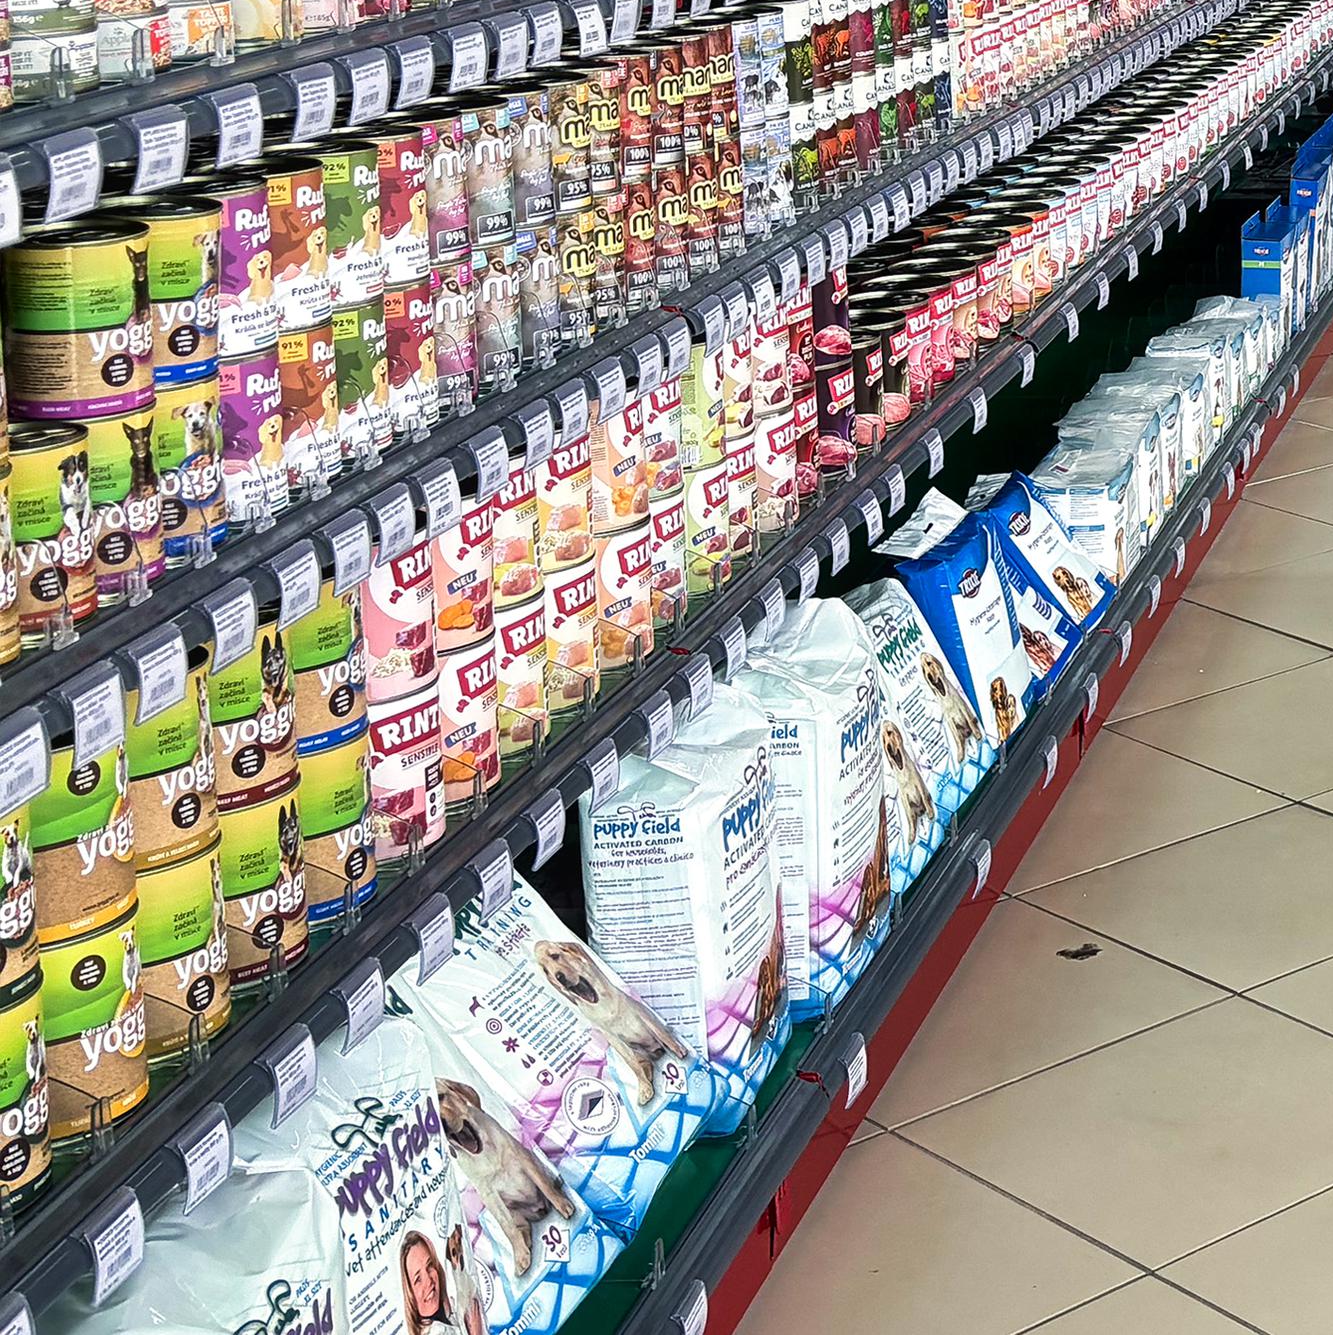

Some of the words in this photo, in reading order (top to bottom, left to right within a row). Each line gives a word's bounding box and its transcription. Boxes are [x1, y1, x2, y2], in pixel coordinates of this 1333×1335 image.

[568, 180, 588, 196] 95%
[486, 214, 509, 231] 99%
[617, 460, 635, 473] NEU
[695, 530, 715, 543] NEU
[453, 577, 475, 593] NEU
[608, 601, 631, 616] NEU
[841, 707, 869, 763] puppy
[593, 819, 637, 840] puppy
[642, 818, 681, 835] field
[722, 792, 760, 852] puppy
[593, 839, 642, 849] ACTIVATED
[645, 836, 684, 847] CARBON
[464, 894, 532, 961] TRAINING
[662, 1063, 680, 1086] 30
[392, 1096, 441, 1169] field
[349, 1146, 444, 1253] SANITARY
[542, 1225, 562, 1252] 30
